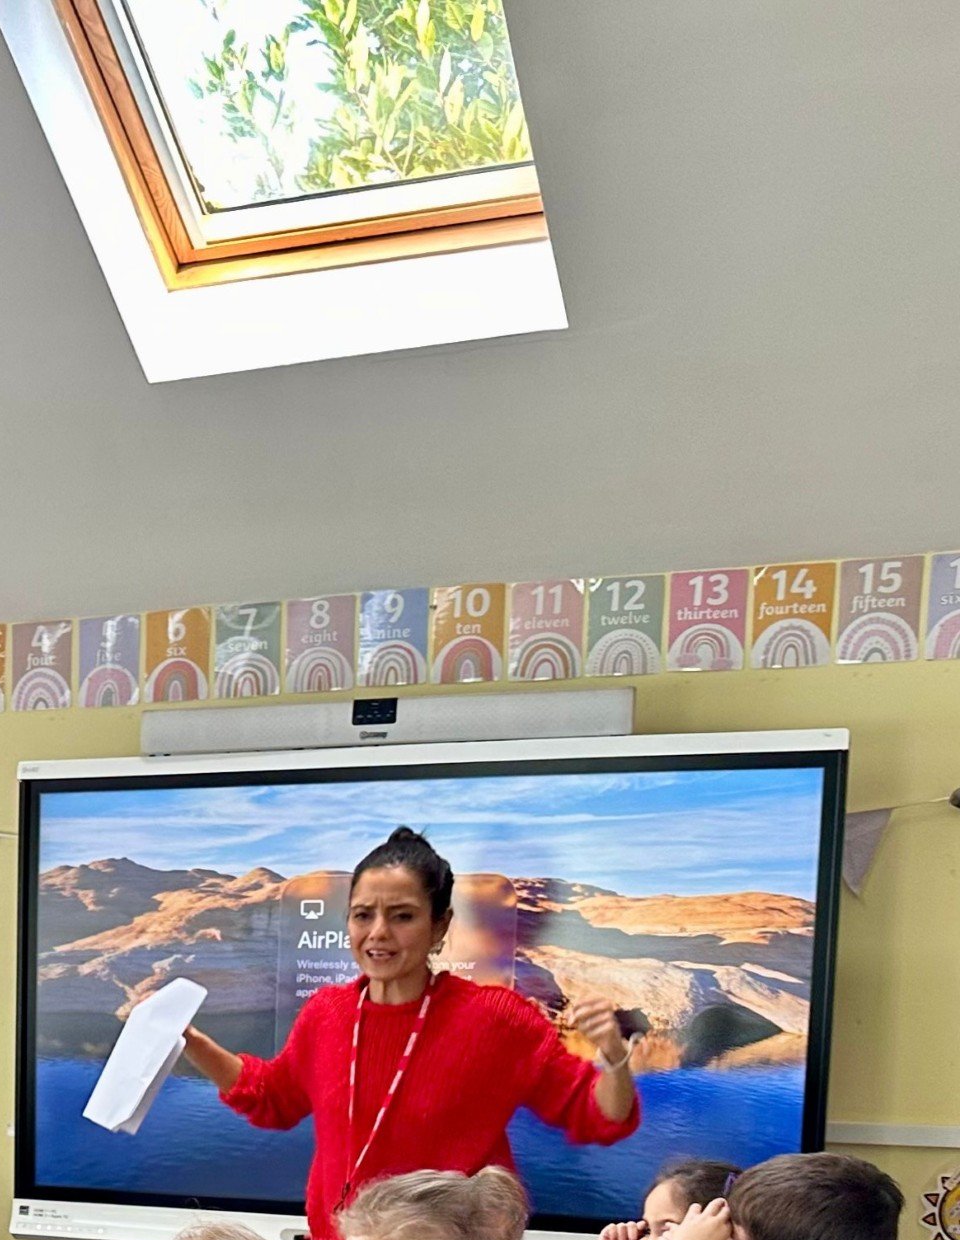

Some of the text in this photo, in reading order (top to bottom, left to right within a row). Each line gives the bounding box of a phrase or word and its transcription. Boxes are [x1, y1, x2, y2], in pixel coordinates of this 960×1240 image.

[772, 568, 817, 601] 14
[858, 561, 903, 595] 15
[606, 579, 646, 612] 12
[688, 573, 730, 606] 13
[384, 592, 404, 623] 9
[452, 588, 490, 618] 10
[531, 584, 563, 615] 11
[850, 594, 906, 613] fifteen
[309, 600, 330, 629] 8
[601, 612, 650, 626] twelve
[676, 606, 739, 621] thirteen
[758, 601, 827, 620] fourteen
[167, 610, 186, 643] 6
[239, 608, 257, 638] 7
[376, 626, 410, 639] nine
[456, 622, 481, 634] ten
[524, 616, 570, 630] eleven
[31, 625, 51, 653] 4
[228, 638, 268, 652] seven
[301, 629, 337, 646] eight
[166, 645, 187, 657] six
[26, 653, 56, 670] four
[297, 930, 352, 949] AirPla
[296, 959, 349, 971] Wirelessly
[450, 961, 476, 972] your
[296, 973, 334, 984] iPhone,
